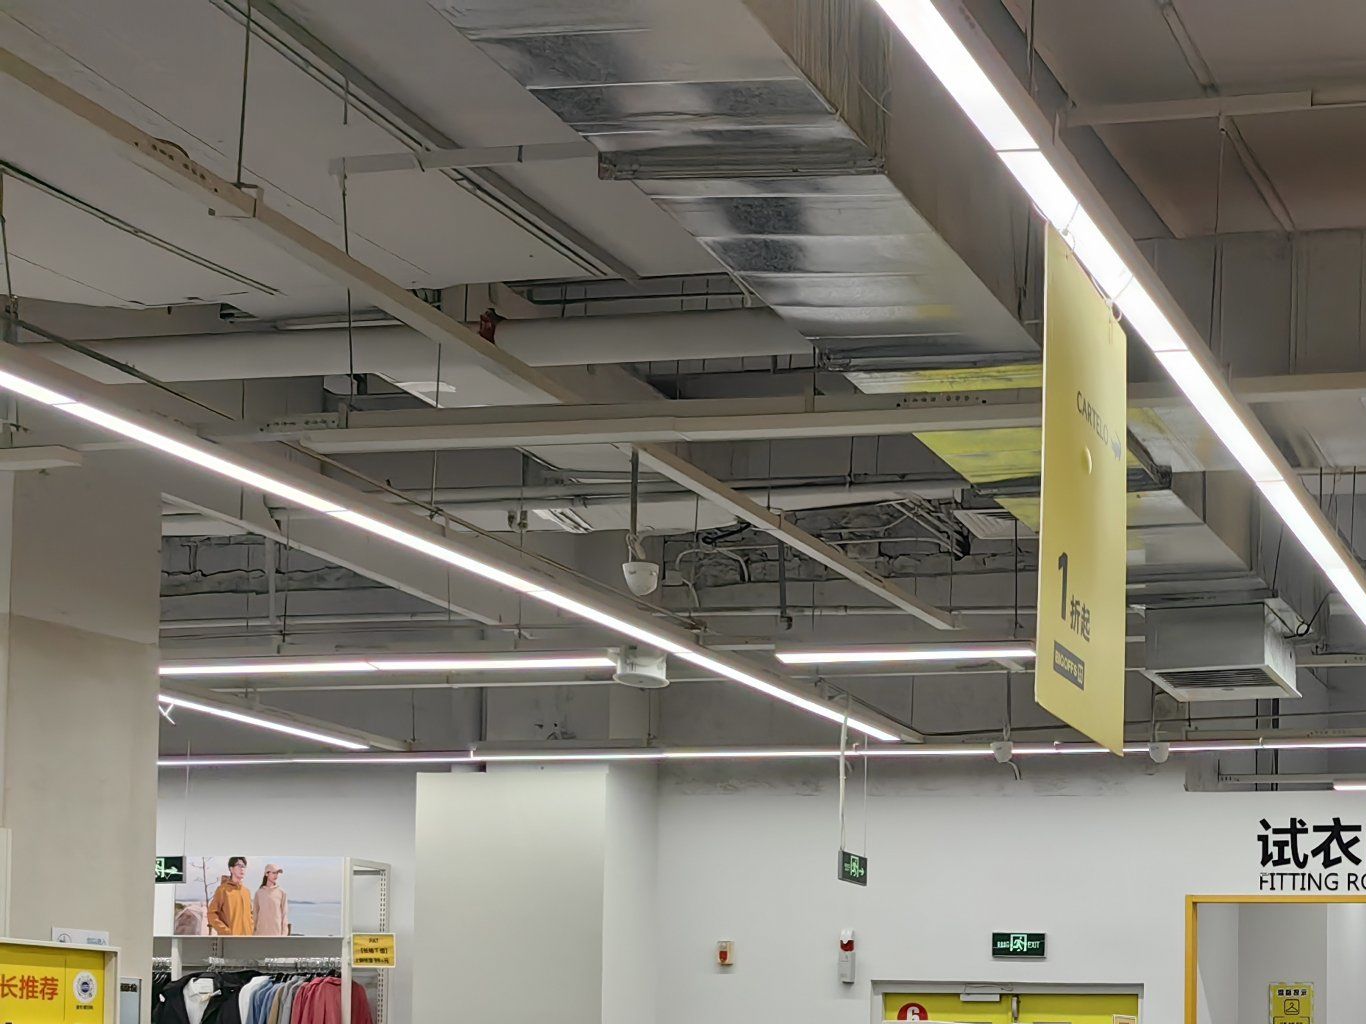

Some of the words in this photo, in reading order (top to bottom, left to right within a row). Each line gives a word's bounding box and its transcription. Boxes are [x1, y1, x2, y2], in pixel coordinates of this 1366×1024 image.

[1076, 390, 1109, 445] CARTELO
[1259, 872, 1339, 892] FITTING
[1027, 941, 1041, 949] EXIT
